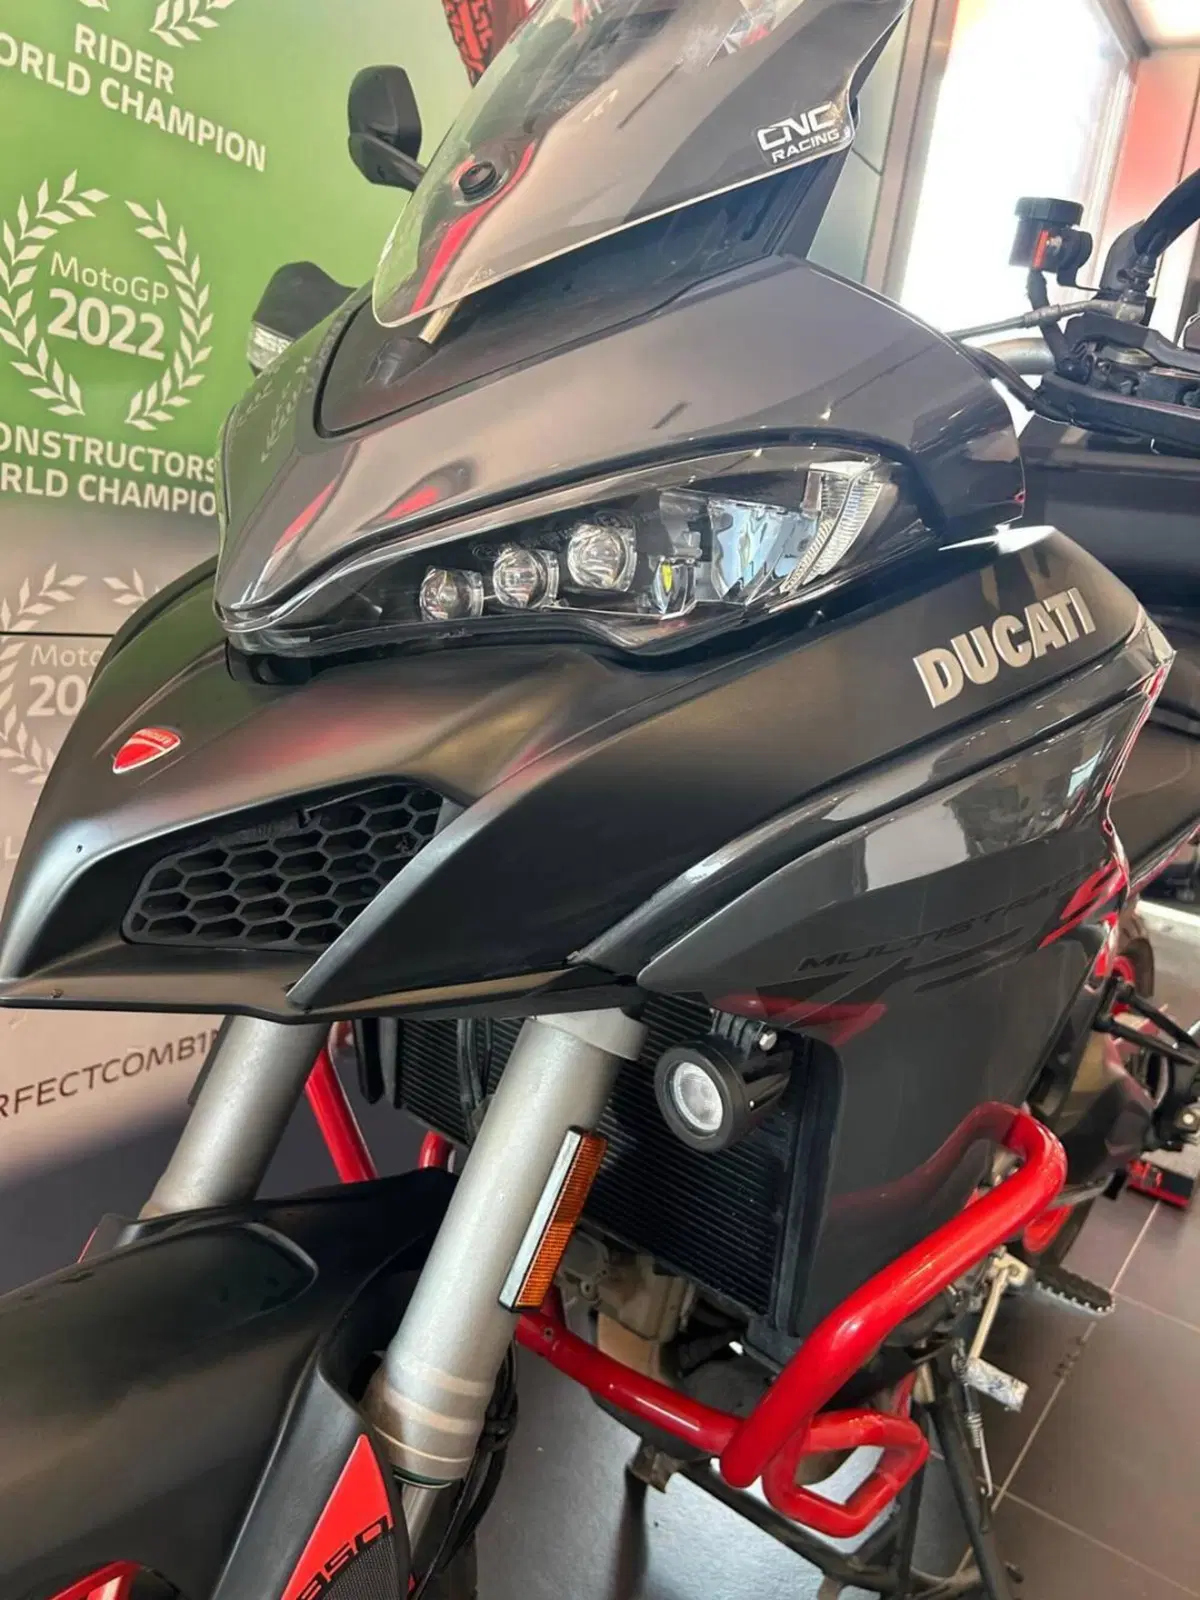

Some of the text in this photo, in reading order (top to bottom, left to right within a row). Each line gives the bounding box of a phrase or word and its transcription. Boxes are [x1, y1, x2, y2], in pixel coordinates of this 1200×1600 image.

[74, 22, 174, 95] RIDER
[100, 77, 266, 172] CHAMPION
[757, 101, 839, 150] CNC
[771, 128, 840, 163] RACING
[51, 251, 169, 305] MotoGP
[47, 288, 165, 361] 2022
[913, 587, 1096, 708] DUCATI
[26, 675, 91, 717] 20
